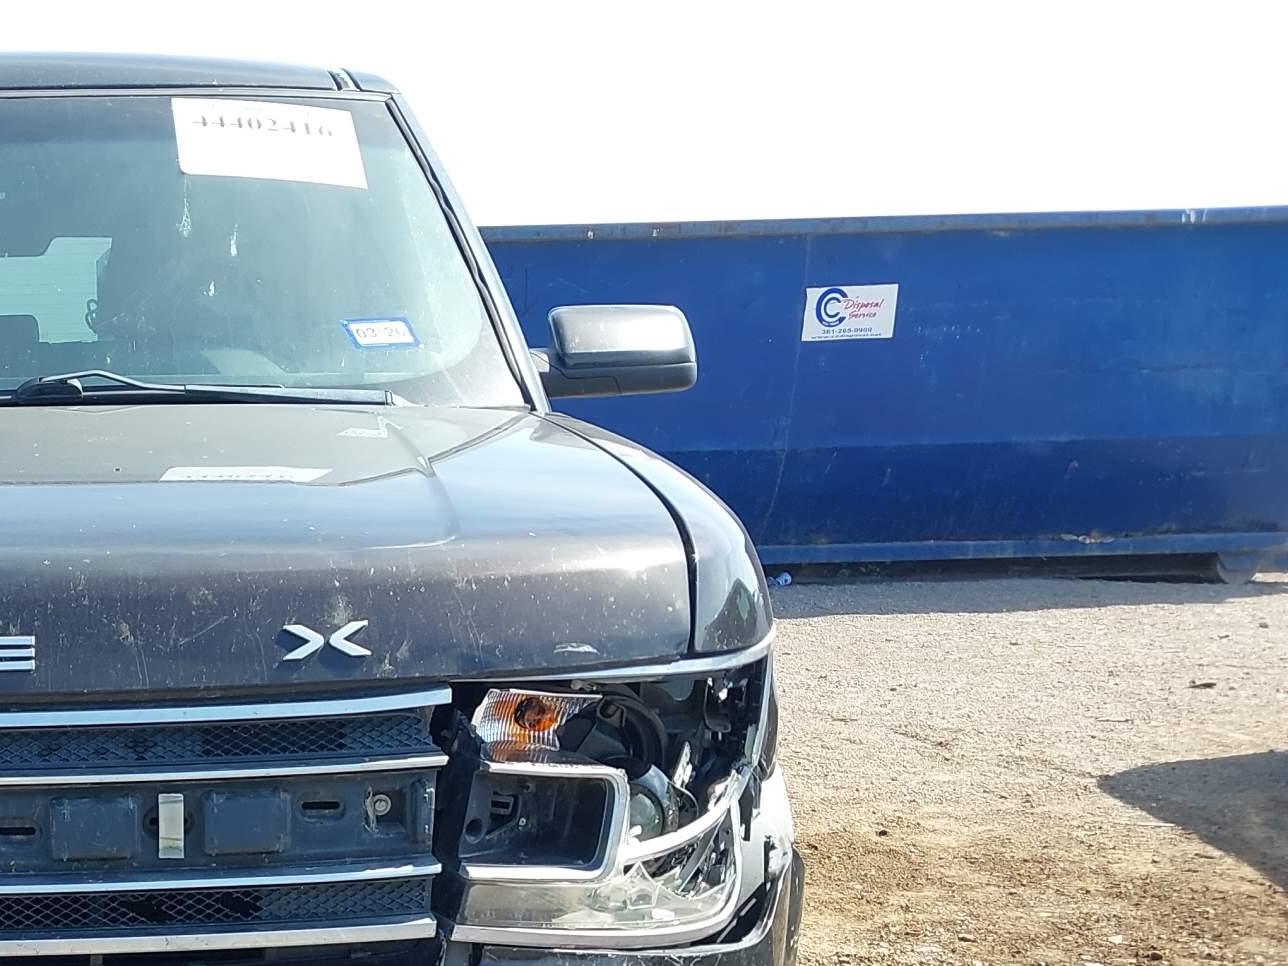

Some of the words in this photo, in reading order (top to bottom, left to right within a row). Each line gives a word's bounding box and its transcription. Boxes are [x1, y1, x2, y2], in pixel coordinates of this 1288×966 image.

[192, 113, 334, 137] 44402416
[841, 297, 884, 312] Disposal
[847, 311, 877, 320] Service
